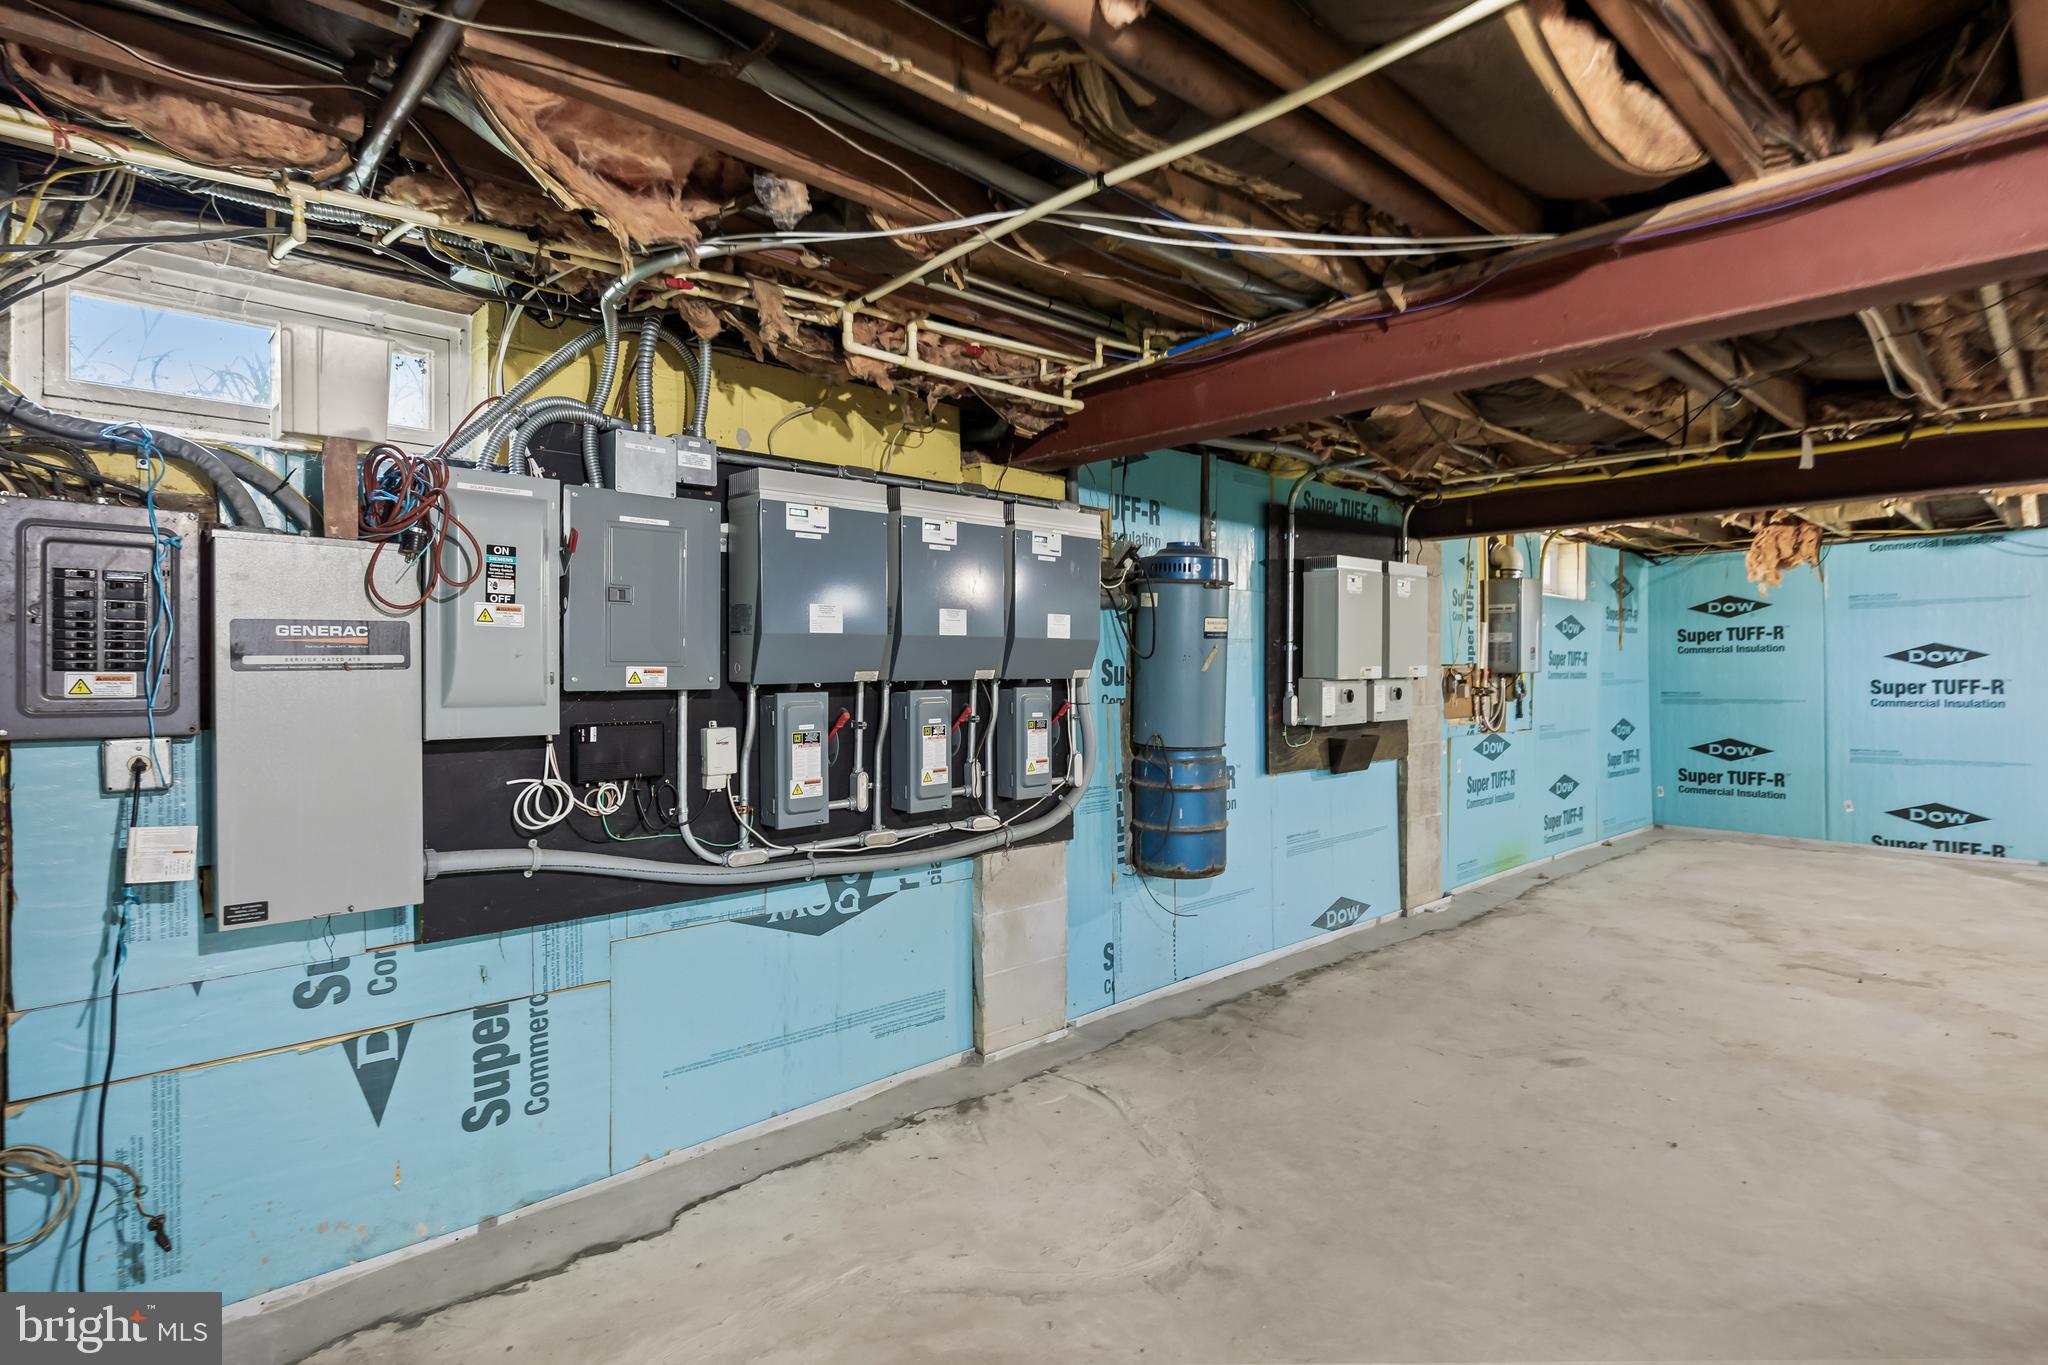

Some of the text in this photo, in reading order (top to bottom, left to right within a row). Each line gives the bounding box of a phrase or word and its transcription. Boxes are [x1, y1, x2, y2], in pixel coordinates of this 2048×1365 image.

[493, 546, 510, 556] ON
[1869, 539, 1939, 552] Commercial
[489, 594, 511, 603] OFF
[275, 625, 369, 637] GENERAC
[1677, 625, 1784, 645] Super TUFF-R
[1677, 644, 1785, 654] Commercial Insulation
[1548, 650, 1567, 669] Super
[1870, 679, 2005, 698] Super TUFF-R
[1870, 698, 2005, 708] Commercial Insulation
[1467, 769, 1516, 795] Super TUFF-R
[1678, 768, 1785, 787] Super TUFF-R
[1678, 785, 1787, 799] Commercial Insulation
[1544, 815, 1562, 832] Super
